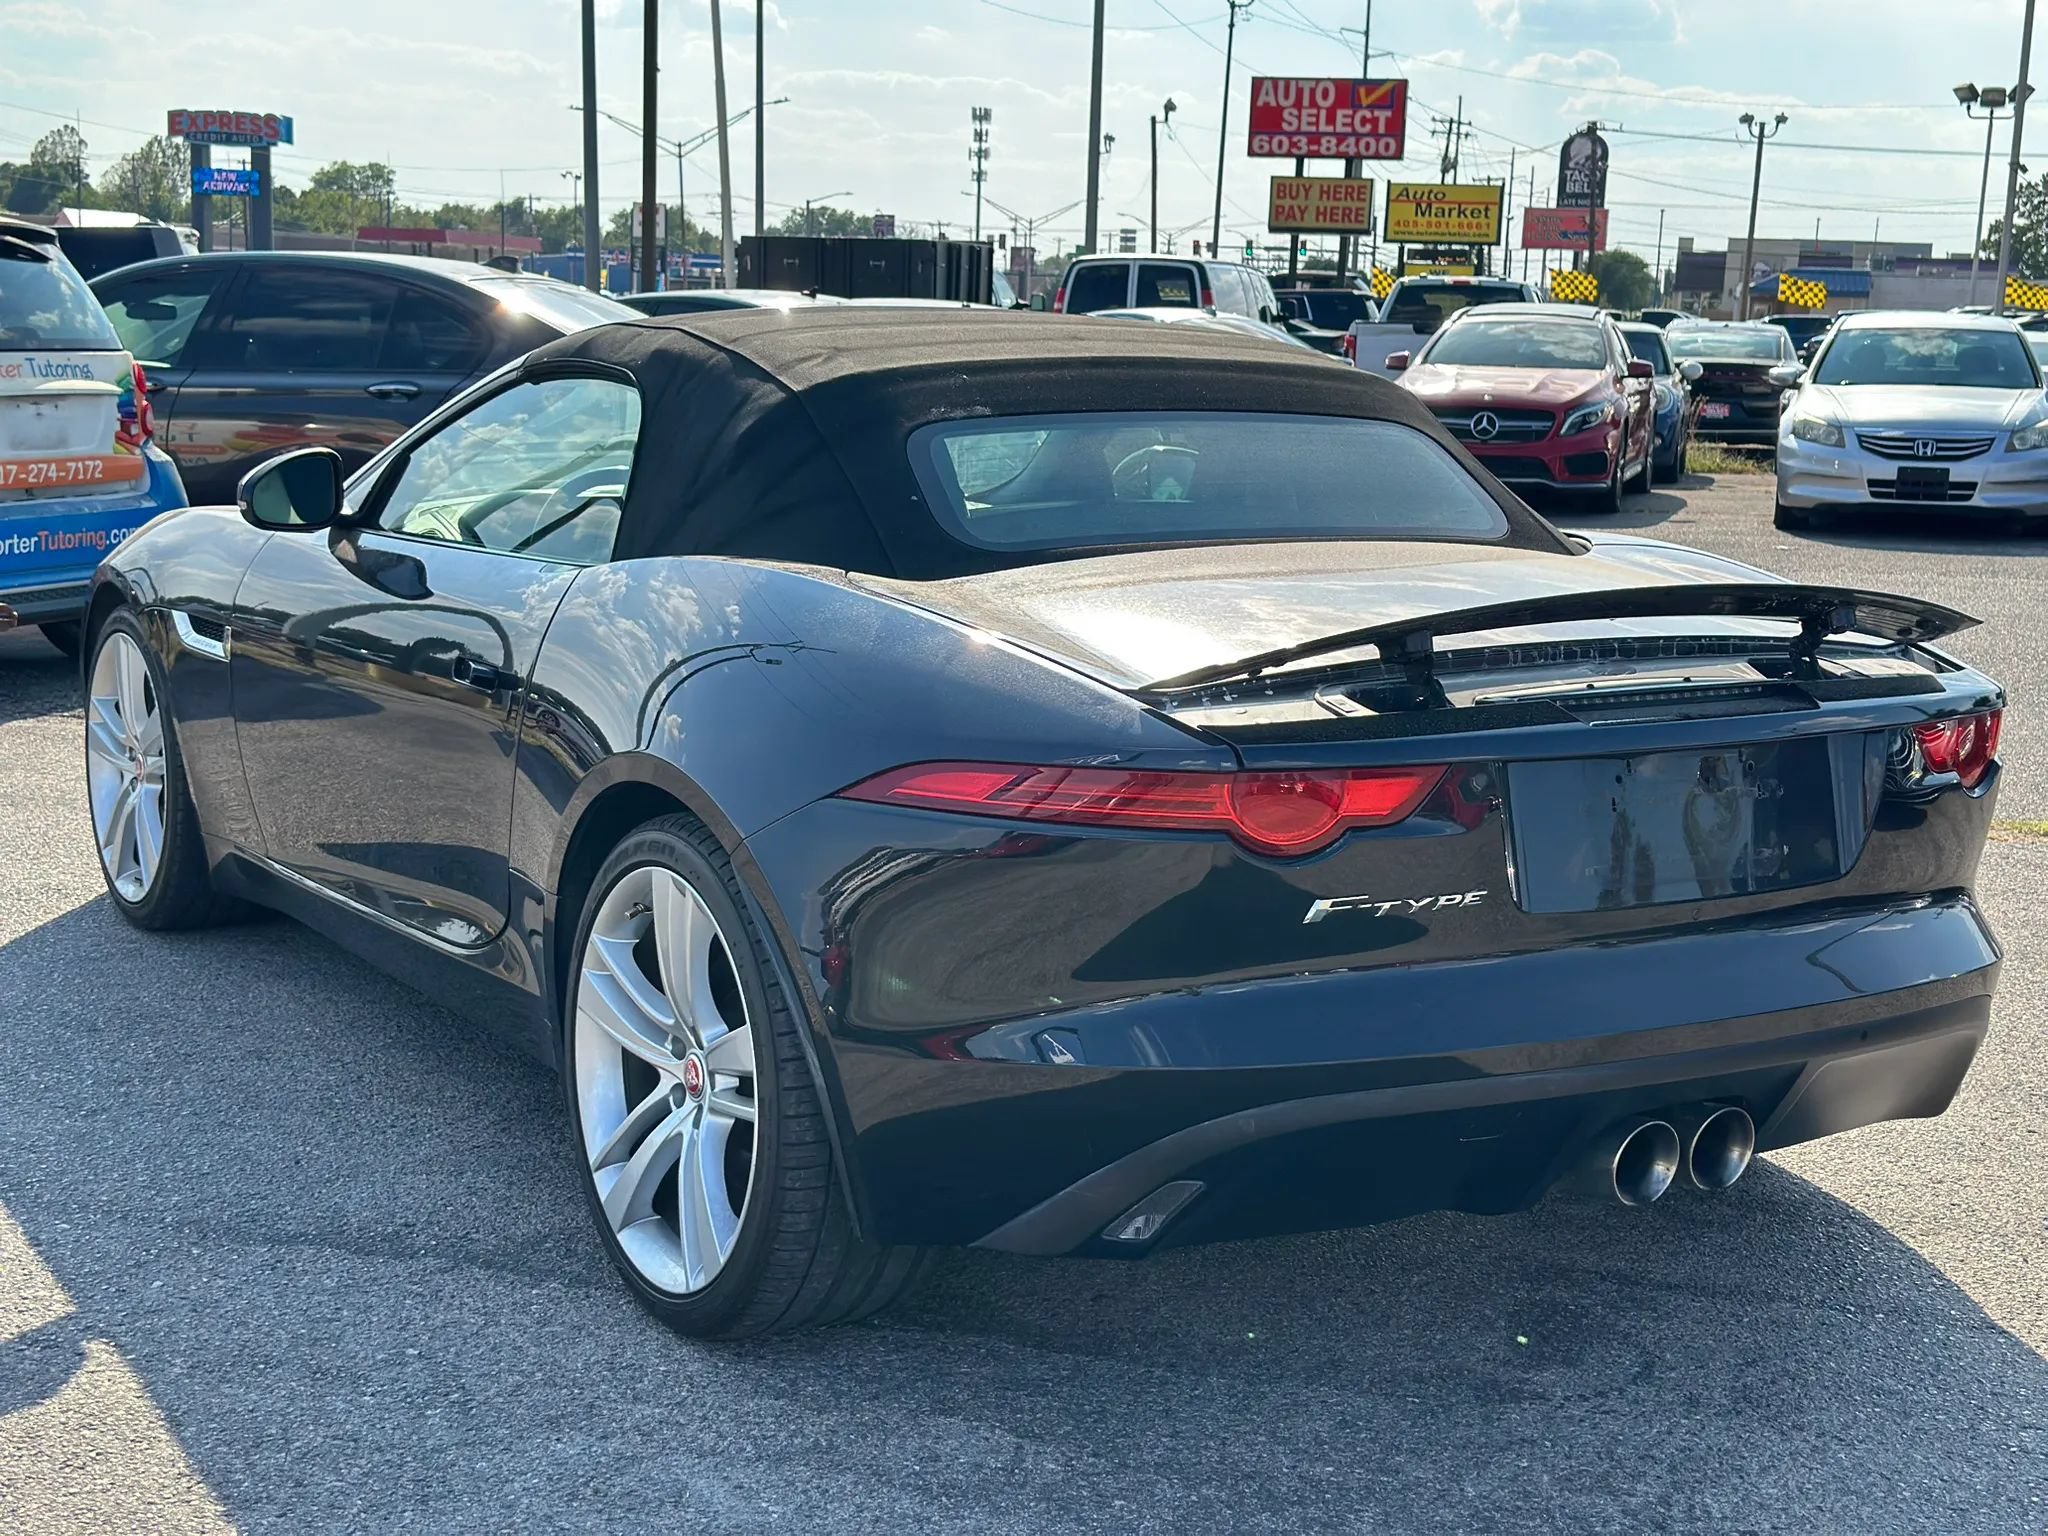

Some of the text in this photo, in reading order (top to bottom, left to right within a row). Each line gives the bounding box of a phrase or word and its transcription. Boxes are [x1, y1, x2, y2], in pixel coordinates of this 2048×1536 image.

[1256, 79, 1336, 108] AUTO
[170, 112, 282, 139] EXPRESS
[1281, 108, 1392, 134] SELECT
[189, 133, 260, 143] CREDIT AUTO
[1251, 135, 1397, 157] 603-8400
[213, 171, 237, 181] NEW
[1276, 182, 1368, 202] BUY HERE
[1395, 187, 1446, 201] Auto
[1565, 182, 1599, 194] BEL
[1273, 205, 1366, 224] PAY HERE
[1414, 202, 1491, 220] Market
[24, 357, 94, 381] Tutoring
[0, 459, 103, 484] 17-274-7172
[1302, 890, 1488, 924] F-TYPE
